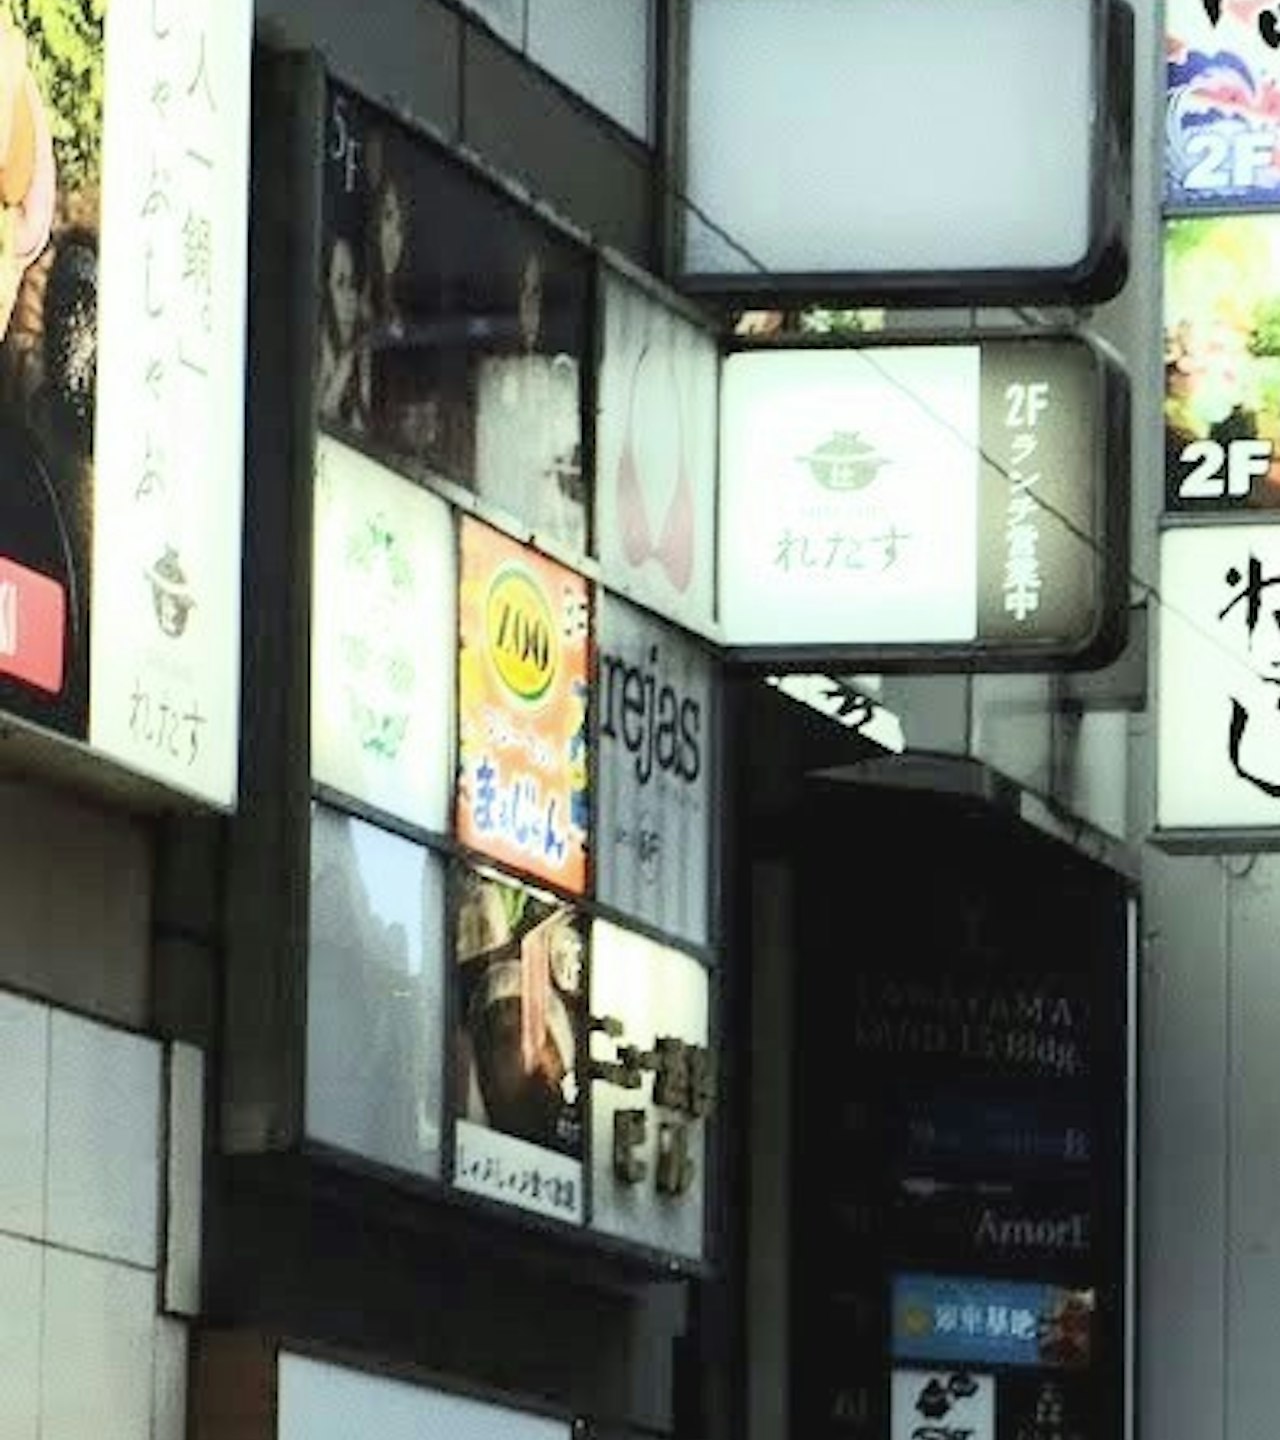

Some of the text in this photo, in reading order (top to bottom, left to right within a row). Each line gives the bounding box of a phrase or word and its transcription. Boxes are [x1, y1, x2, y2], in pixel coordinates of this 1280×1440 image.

[1004, 382, 1050, 427] 2F
[1179, 440, 1273, 499] 2F
[600, 648, 701, 786] rejas
